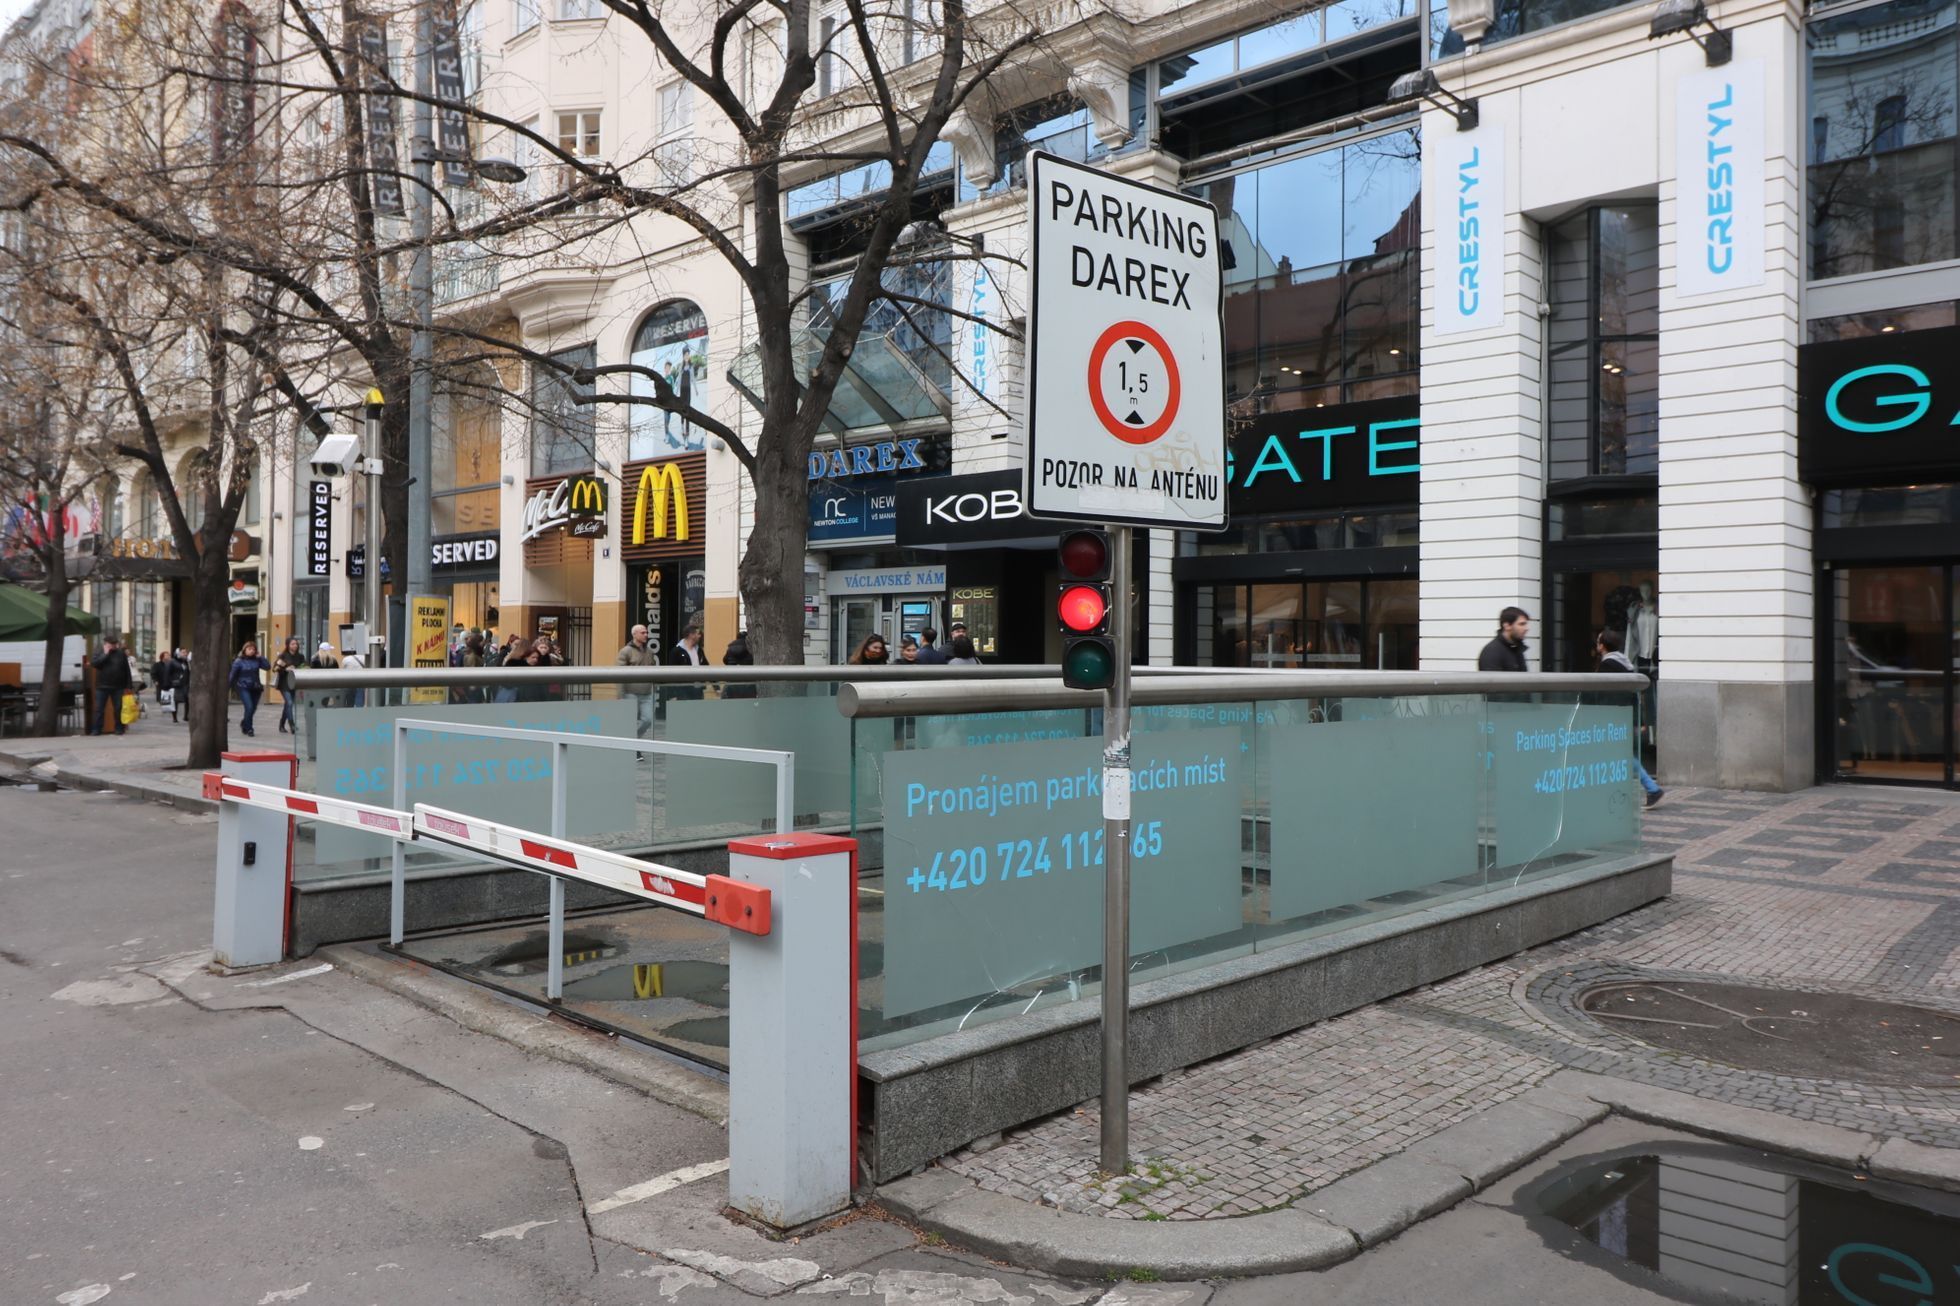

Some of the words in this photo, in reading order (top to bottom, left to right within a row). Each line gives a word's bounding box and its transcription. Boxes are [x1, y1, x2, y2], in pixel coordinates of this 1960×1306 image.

[433, 8, 469, 178] RESERVE
[1707, 83, 1733, 274] CRESTYL
[1051, 180, 1207, 259] PARKING
[1458, 146, 1479, 316] CRESTYL
[1072, 244, 1192, 311] DAREX
[1130, 396, 1138, 405] m
[1825, 364, 1960, 433] G
[808, 438, 923, 480] DAREX
[1227, 417, 1421, 488] ATE
[1042, 458, 1103, 489] POZOR
[1114, 465, 1138, 489] NA
[1151, 466, 1218, 501] ANTÉNU
[871, 496, 896, 509] NEW
[926, 489, 1023, 525] KOB
[314, 483, 328, 574] RESERVED
[813, 519, 836, 527] NEWTON
[836, 516, 860, 525] COLLEGE
[431, 539, 498, 565] SERVED
[844, 571, 912, 588] VÁCLAVSKÉ
[917, 569, 945, 585] NÁM
[952, 588, 995, 599] KOBE
[422, 618, 442, 628] PLOCHA
[1516, 729, 1556, 753] Parking
[1558, 727, 1591, 747] Spaces
[1593, 724, 1605, 743] for
[1608, 722, 1628, 741] Rent
[907, 773, 1039, 818] Pronájem
[1047, 758, 1177, 809] parkacích
[1184, 754, 1226, 785] míst
[1534, 769, 1563, 793] +420
[1565, 766, 1586, 790] 724
[1588, 763, 1608, 786] 112
[1609, 759, 1628, 783] 365
[907, 846, 987, 893] +420
[997, 836, 1051, 881] 724
[1130, 820, 1162, 858] 65
